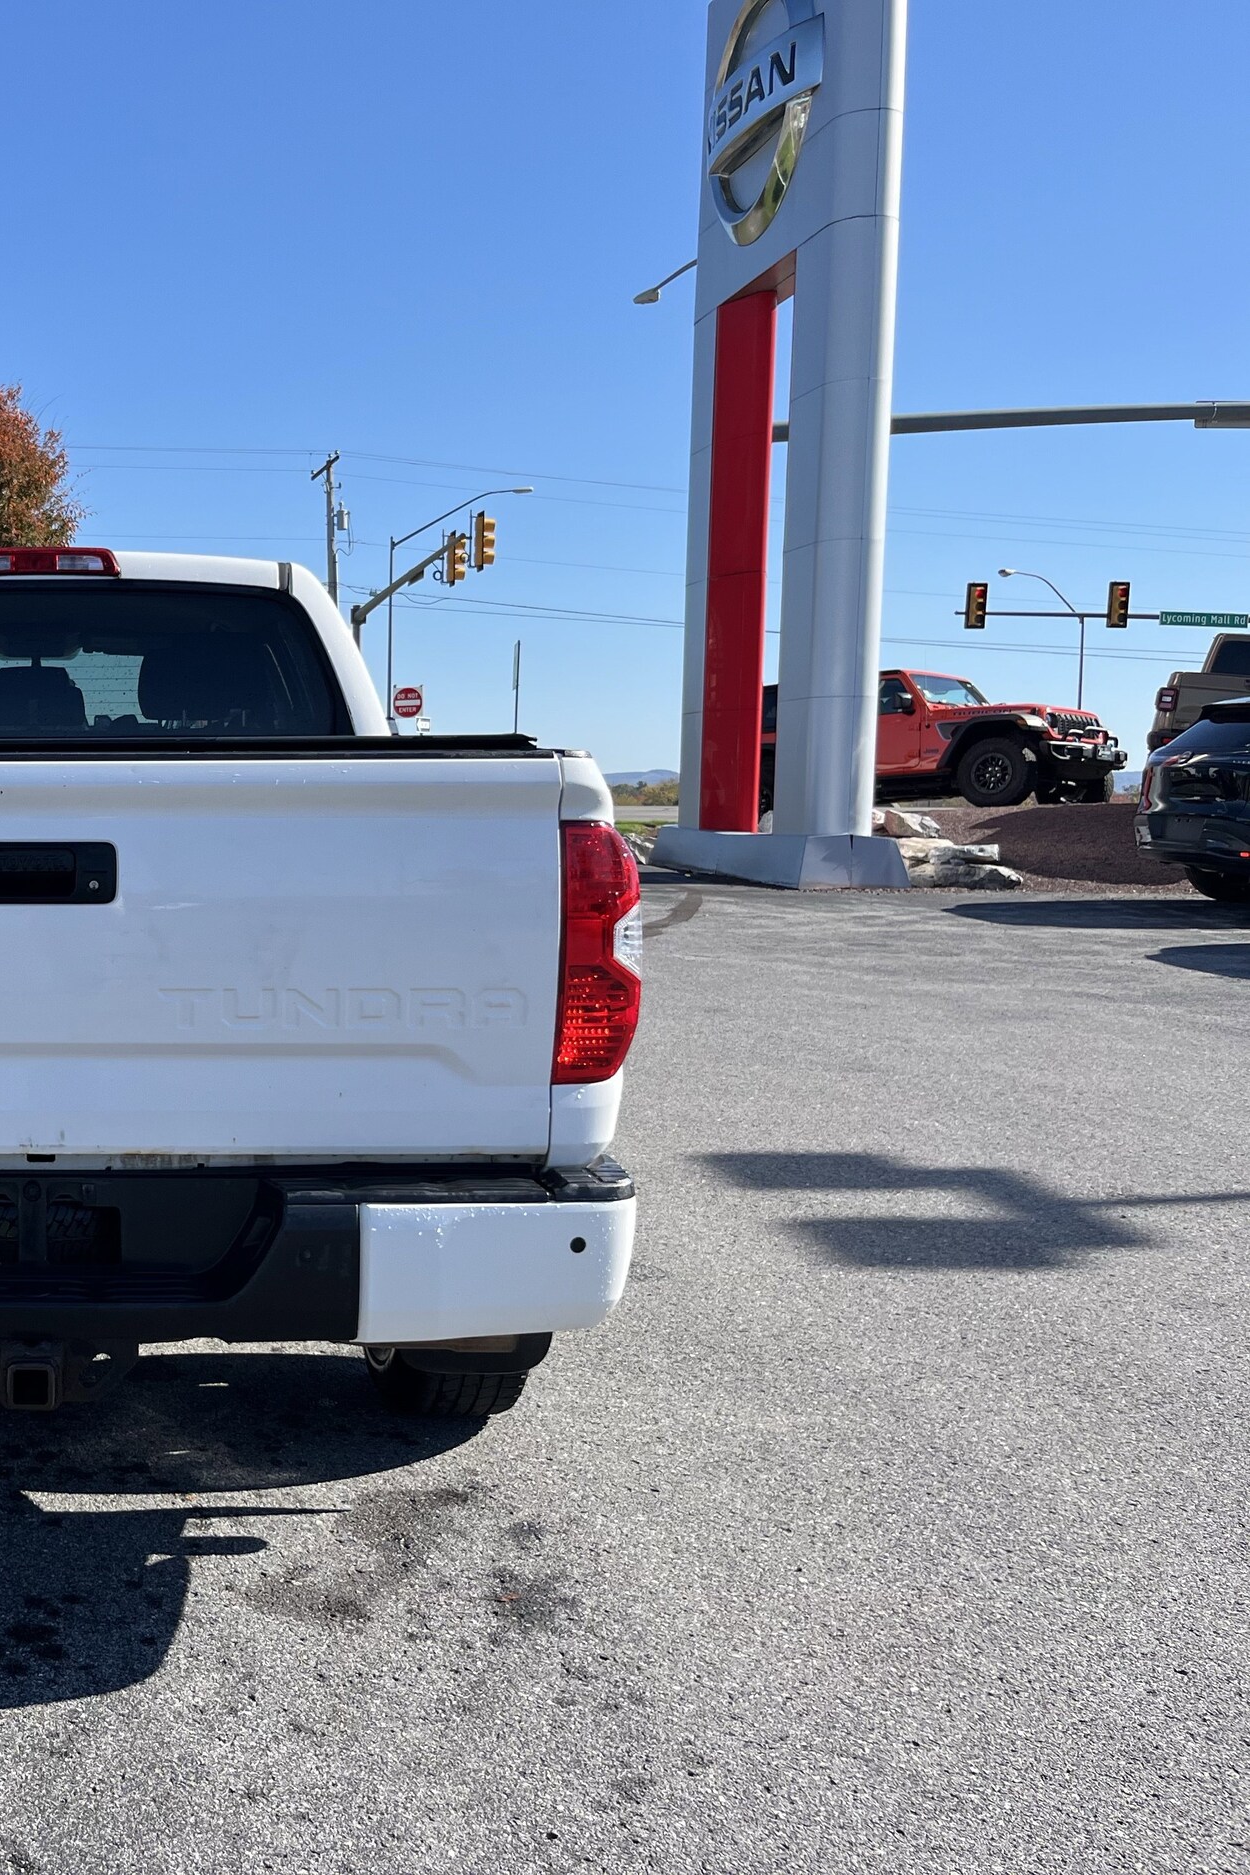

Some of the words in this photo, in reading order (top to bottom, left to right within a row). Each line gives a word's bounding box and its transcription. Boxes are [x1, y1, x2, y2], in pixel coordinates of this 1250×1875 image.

[1162, 614, 1207, 625] Lycoming
[1210, 616, 1230, 624] Mall
[1234, 617, 1246, 625] Rd
[158, 988, 528, 1029] TUNDRA
